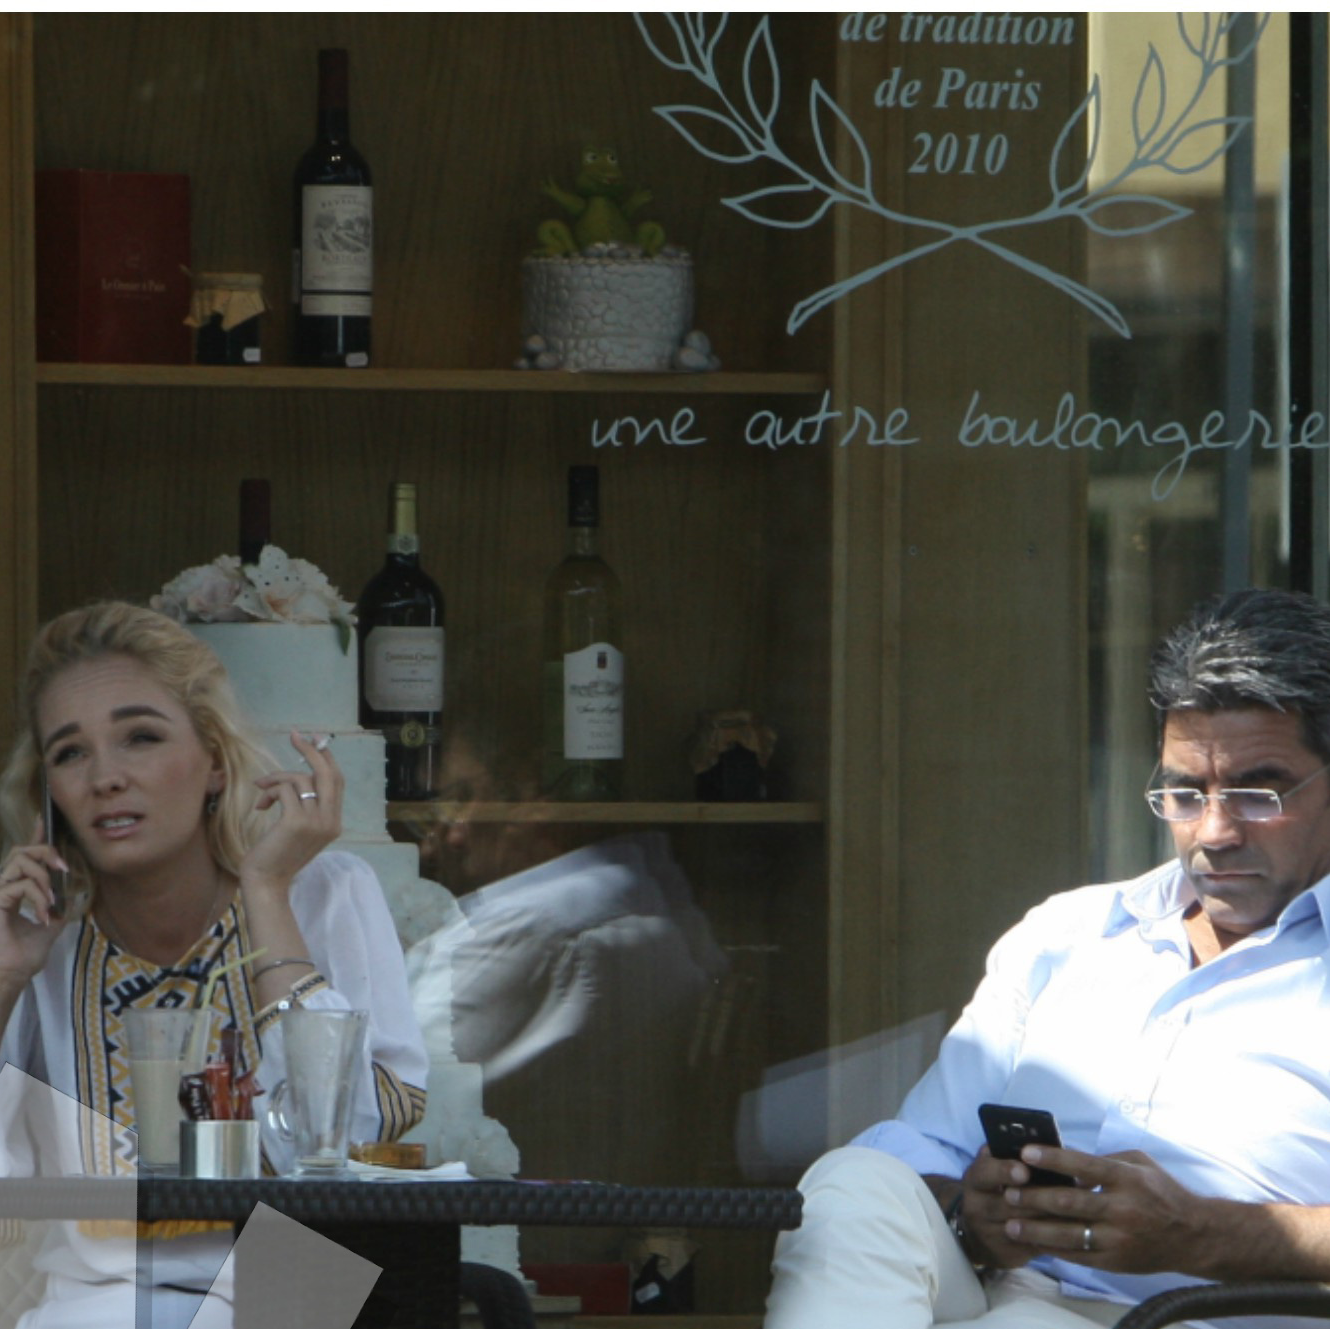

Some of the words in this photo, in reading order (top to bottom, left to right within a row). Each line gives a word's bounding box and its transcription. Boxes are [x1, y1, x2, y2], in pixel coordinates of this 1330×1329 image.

[839, 12, 887, 42] de
[898, 12, 1075, 45] tradition
[874, 67, 921, 109] de
[932, 67, 1041, 110] Paris
[908, 132, 1009, 175] 2010
[591, 406, 707, 448] une
[744, 389, 920, 450] autre
